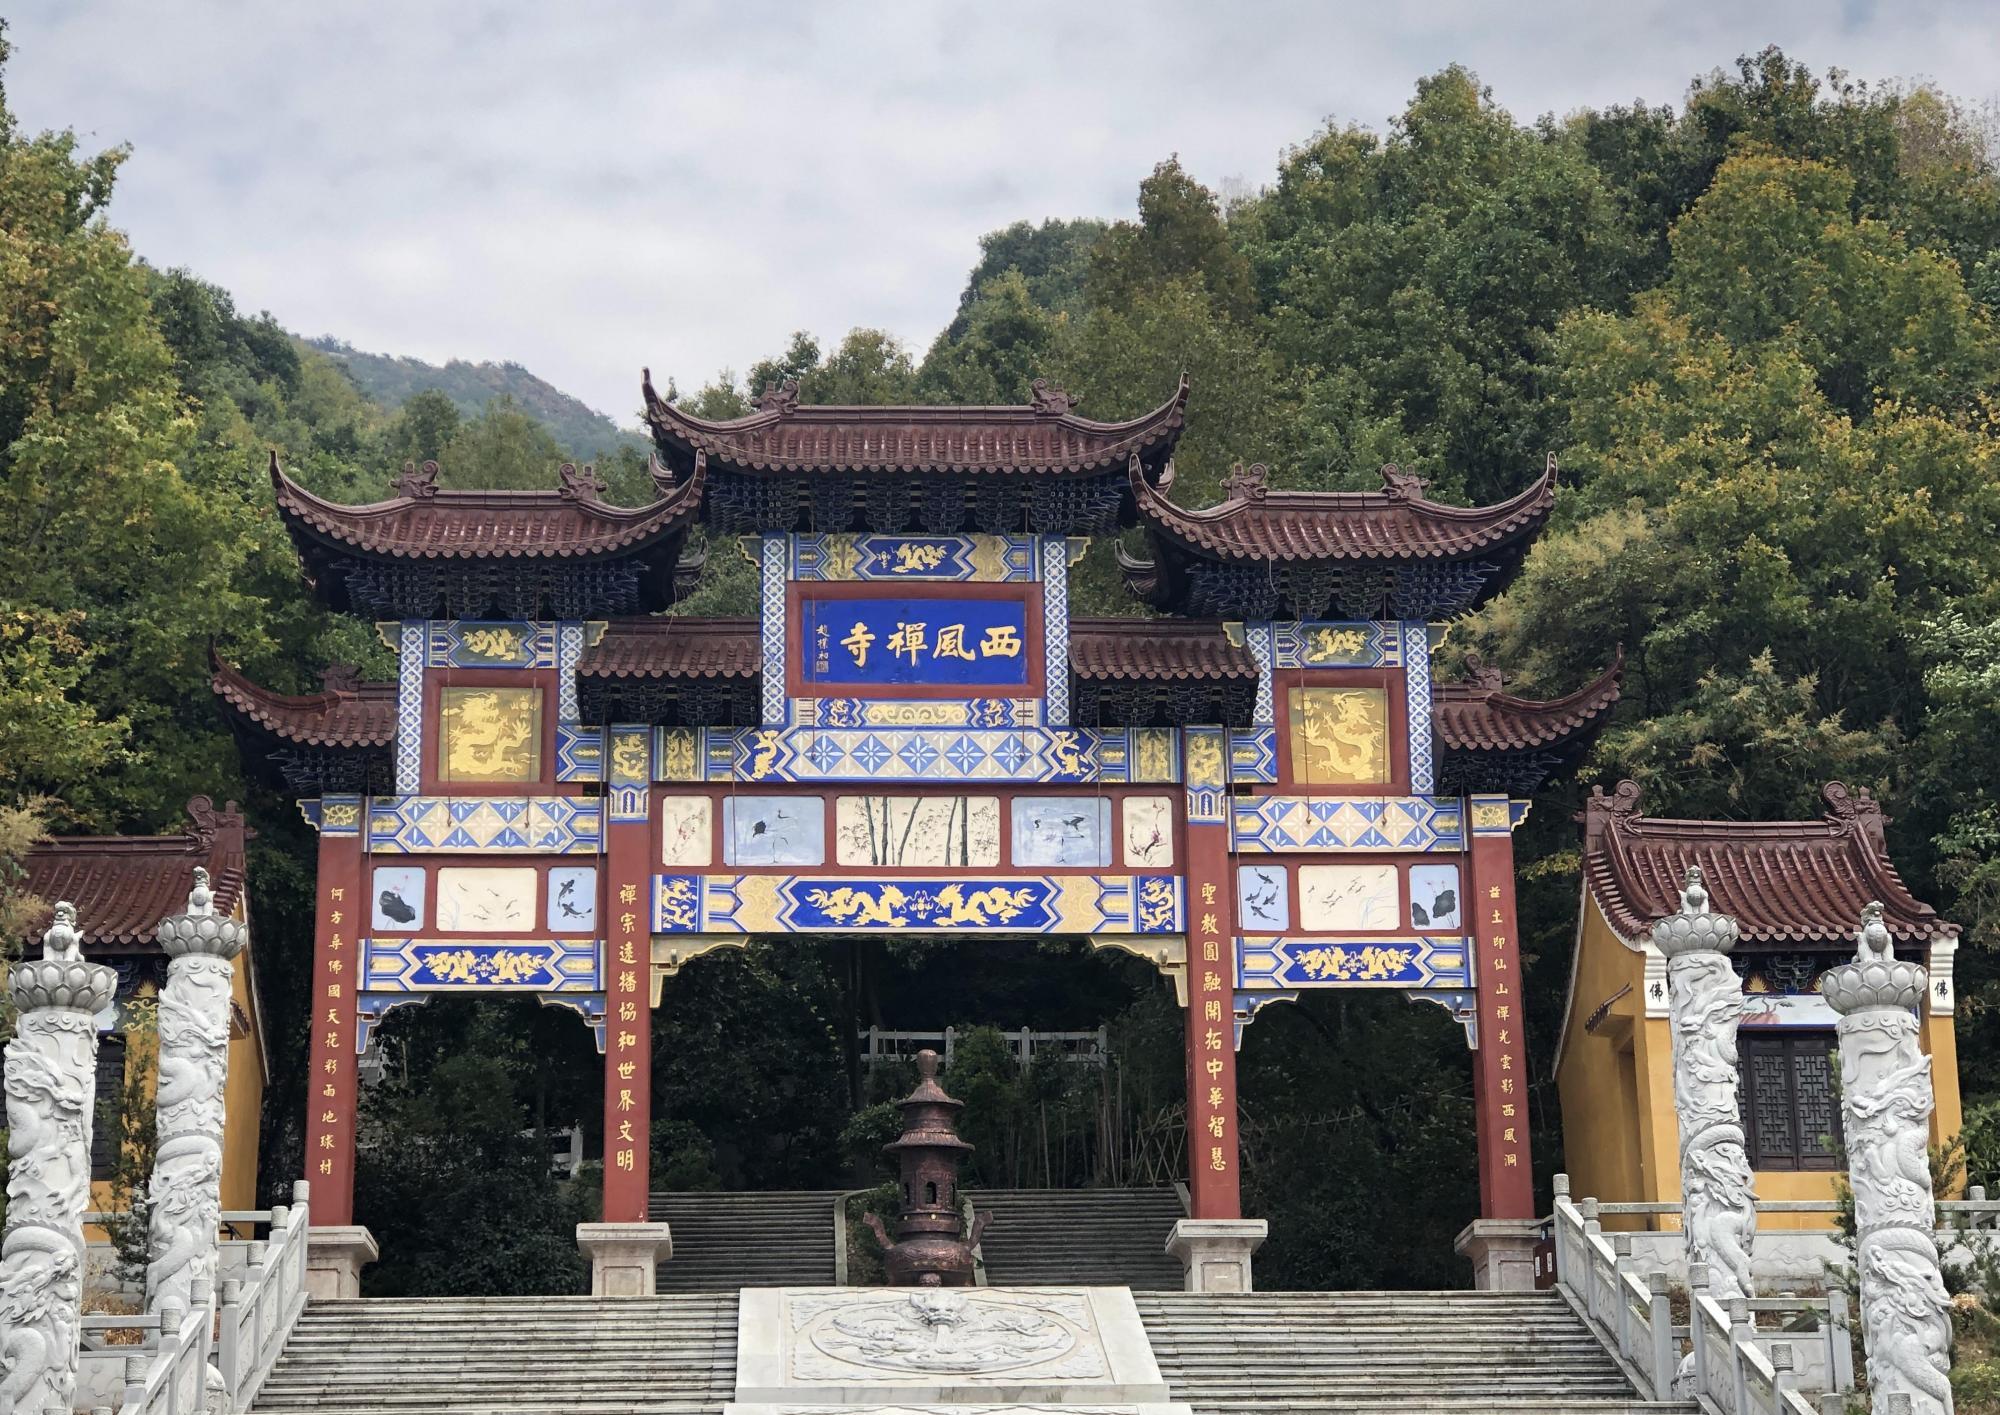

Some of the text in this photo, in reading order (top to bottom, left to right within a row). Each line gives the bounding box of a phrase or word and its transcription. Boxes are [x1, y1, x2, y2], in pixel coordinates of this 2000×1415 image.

[840, 621, 1022, 667] 西風禪寺
[1650, 980, 1664, 1003] 佛
[1934, 979, 1949, 1001] 佛
[616, 883, 638, 1172] 禪宗遠播協和世界文明
